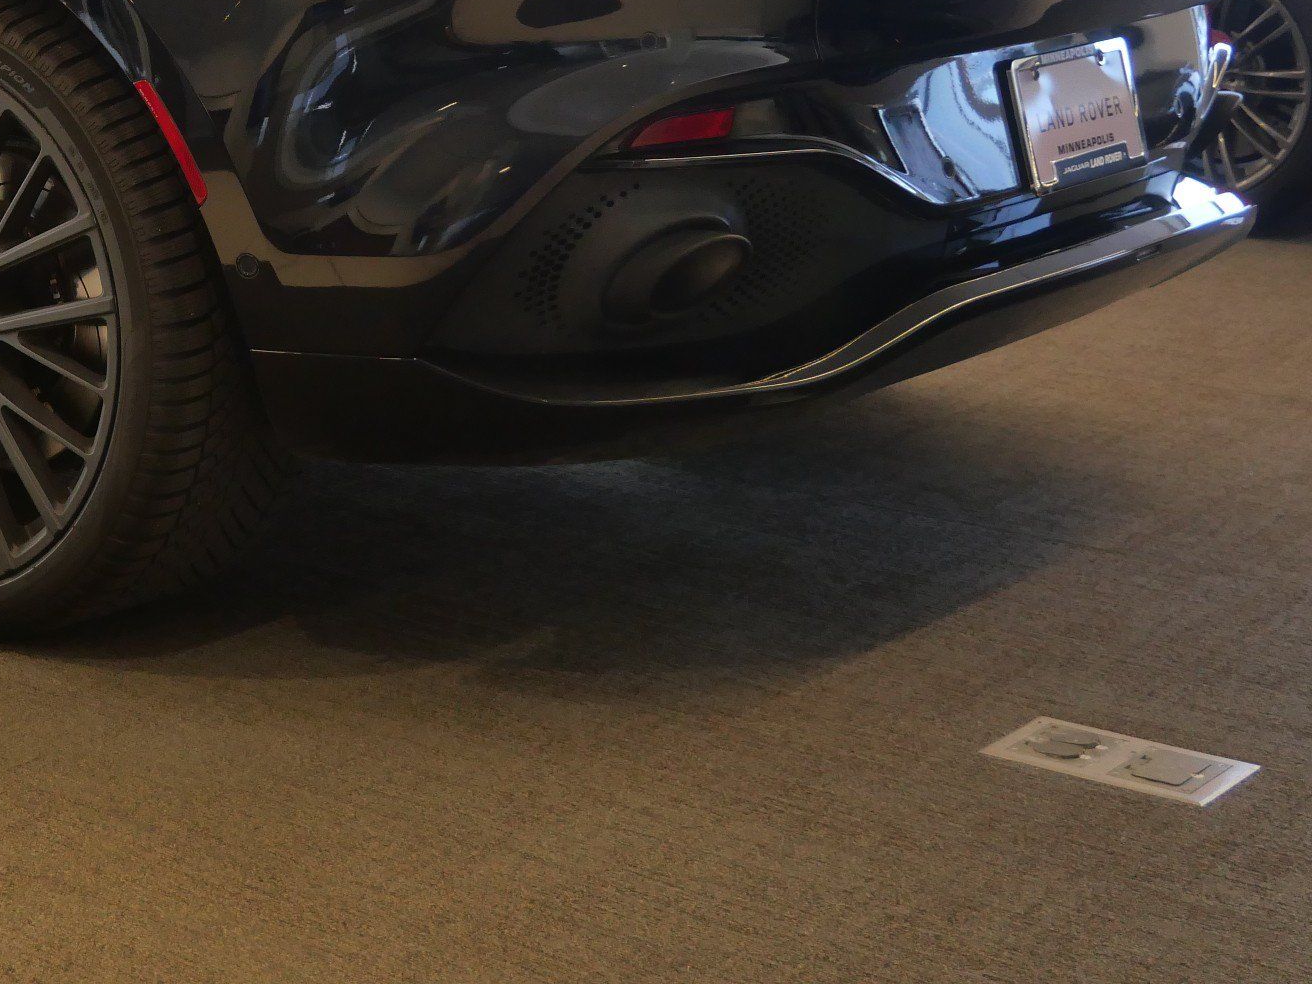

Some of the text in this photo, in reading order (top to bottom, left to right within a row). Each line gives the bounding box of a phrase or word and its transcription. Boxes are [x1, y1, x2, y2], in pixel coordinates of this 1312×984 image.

[1037, 95, 1123, 133] LAND ROVER
[1057, 132, 1115, 155] MINNEAPOLIS
